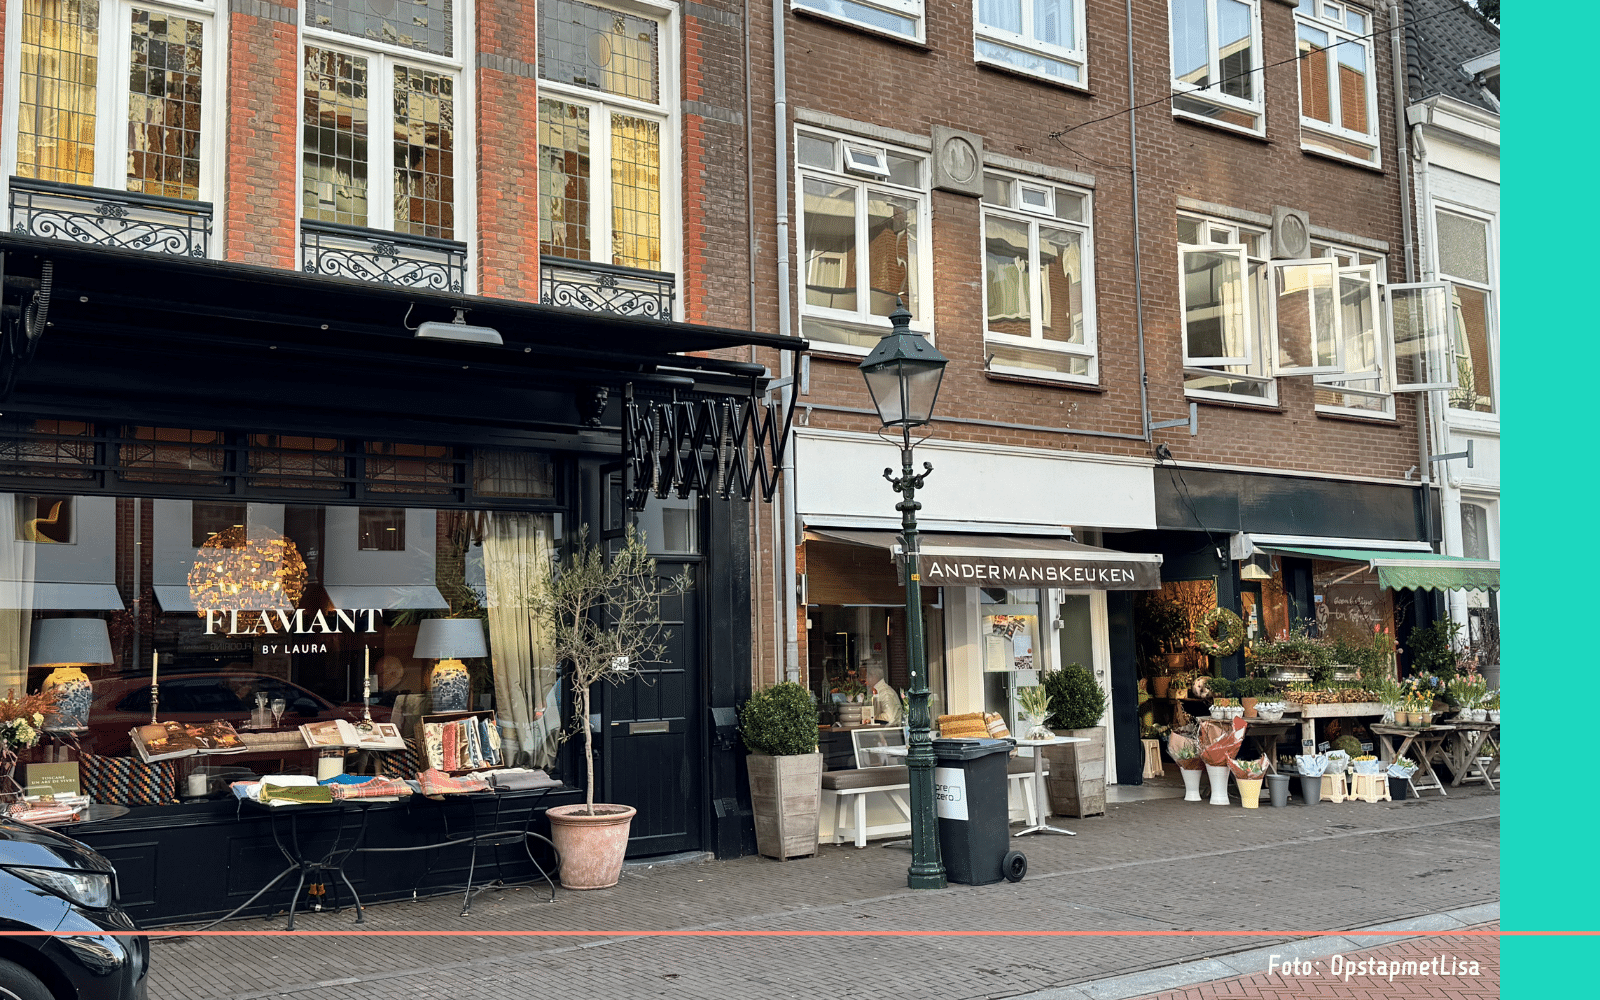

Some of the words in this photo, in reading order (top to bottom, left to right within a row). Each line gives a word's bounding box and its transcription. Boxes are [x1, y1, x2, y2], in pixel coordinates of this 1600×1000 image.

[203, 608, 383, 635] FLAMANT
[262, 644, 278, 655] BY
[284, 643, 327, 654] LAURA
[936, 793, 954, 801] zero
